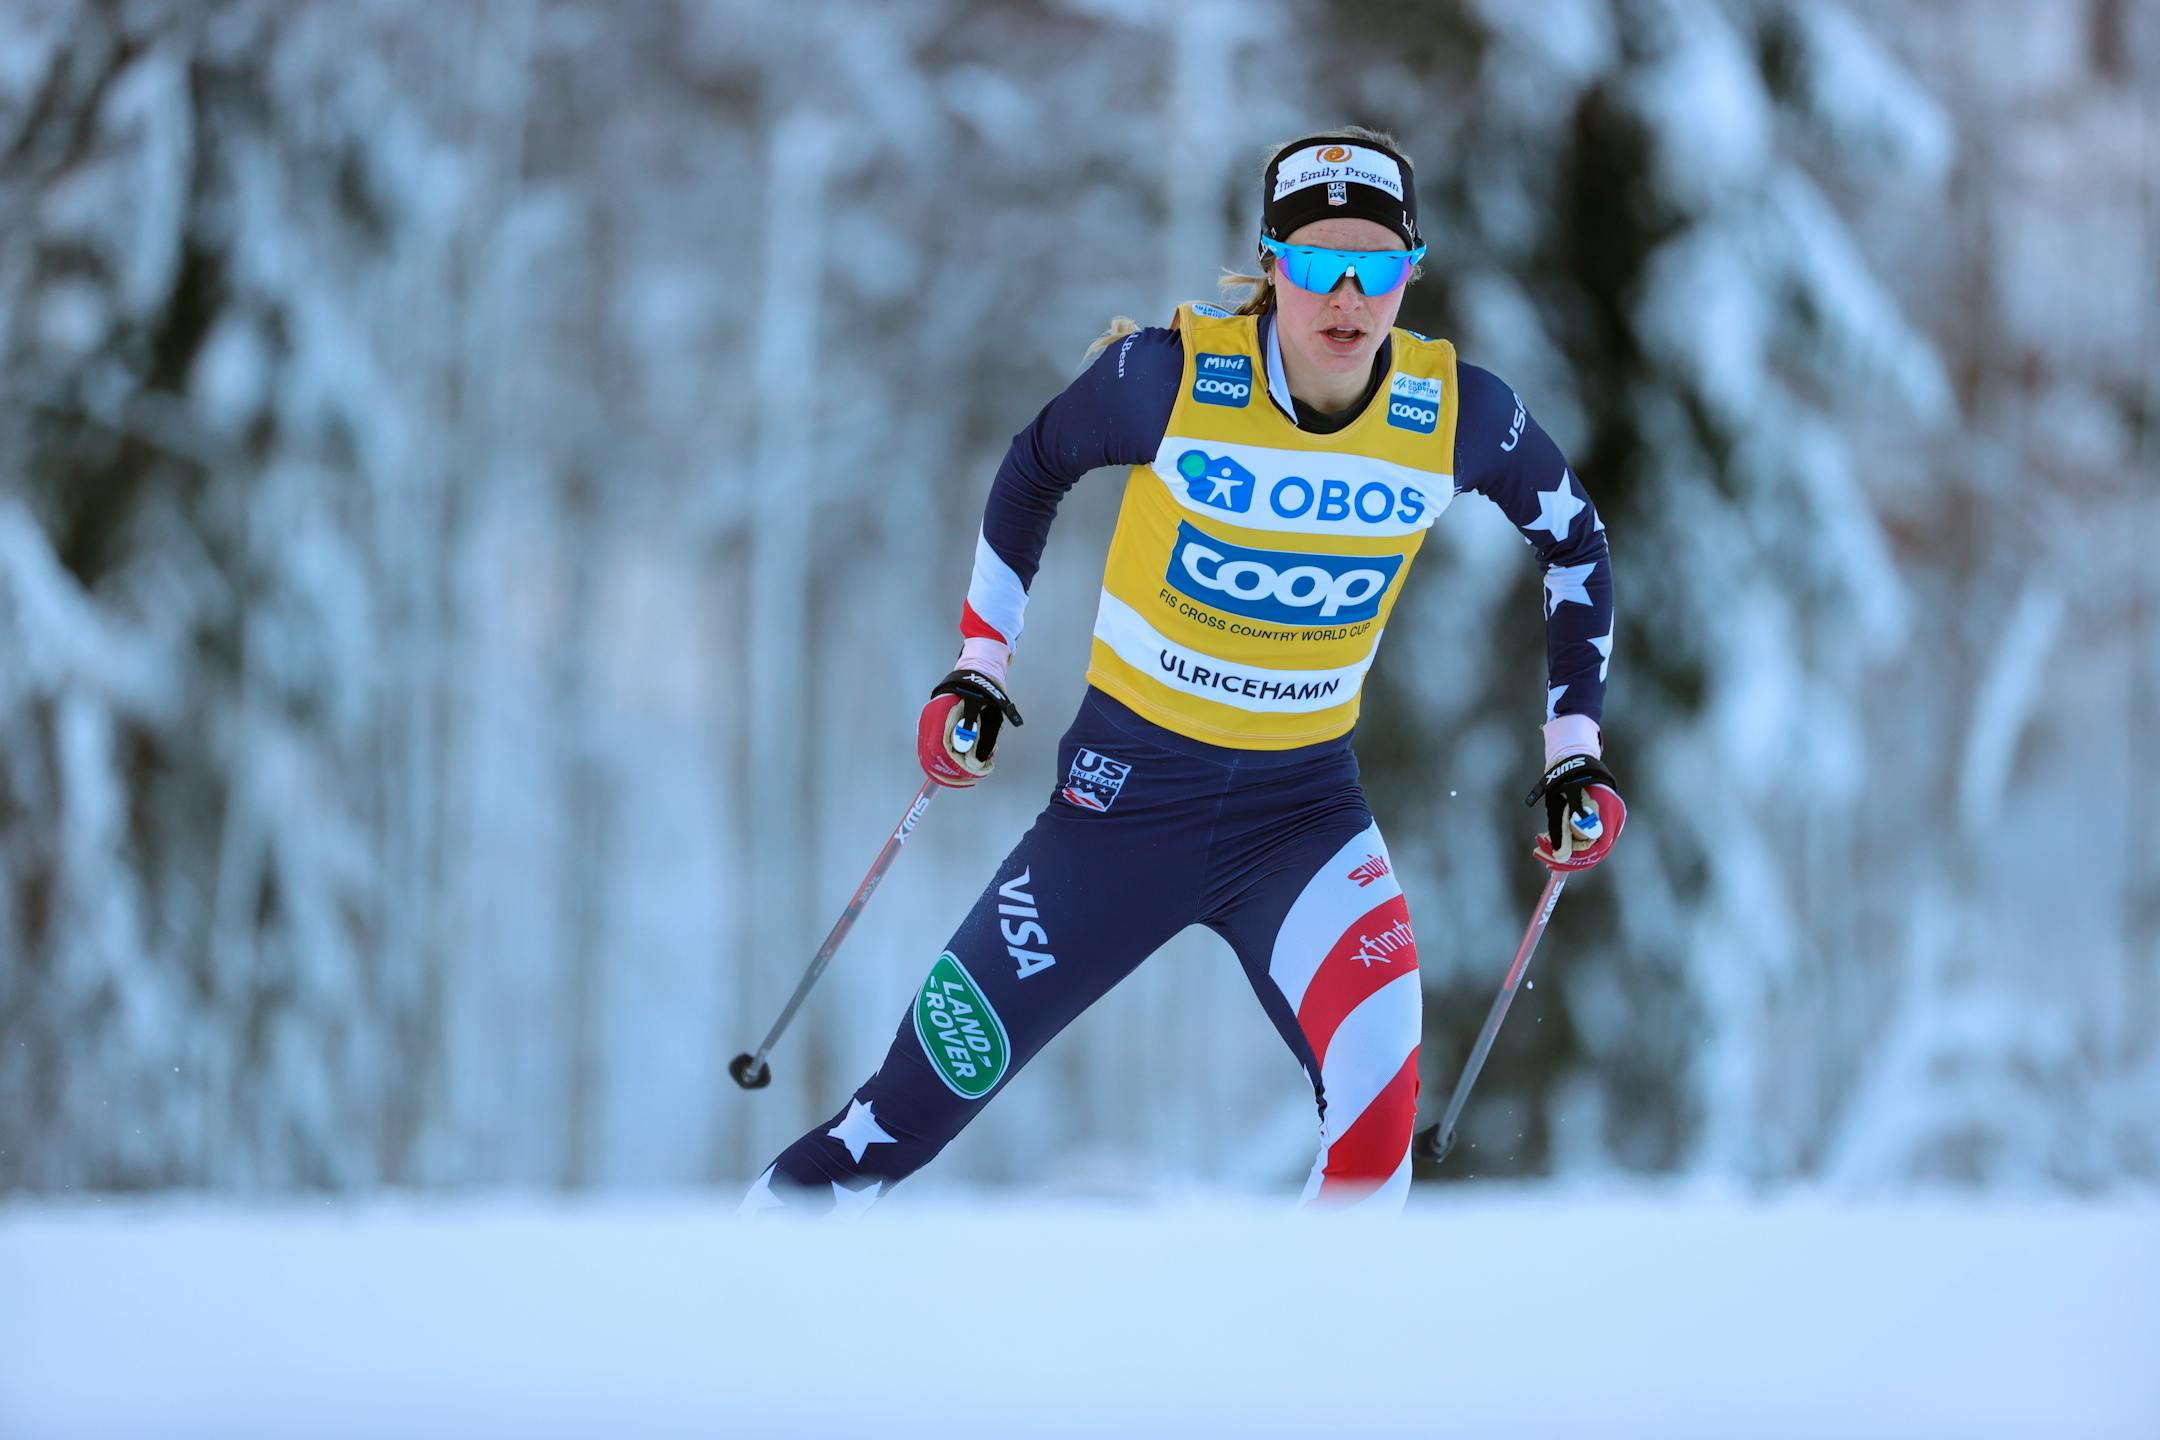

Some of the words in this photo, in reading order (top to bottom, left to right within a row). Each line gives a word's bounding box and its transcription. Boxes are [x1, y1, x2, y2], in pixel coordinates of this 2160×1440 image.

[1279, 179, 1296, 192] The
[1300, 166, 1339, 183] Emily
[1345, 167, 1399, 193] Program
[1195, 378, 1249, 399] coop
[1390, 402, 1436, 426] coop
[1500, 392, 1527, 452] USA
[1270, 476, 1426, 524] OBOS
[1181, 542, 1386, 617] coop
[1159, 588, 1178, 608] FIS
[1179, 602, 1227, 631] CROSS
[1230, 623, 1298, 641] COUNTRY
[1301, 628, 1347, 641] WORLD
[1349, 622, 1371, 637] CUP
[1159, 648, 1341, 700] ULRICEHAMN
[1071, 768, 1089, 778] SKI
[1090, 775, 1120, 789] TEAM
[1075, 750, 1129, 780] US
[998, 865, 1057, 980] VISA
[925, 991, 977, 1078] ROVER
[942, 980, 992, 1053] LAND
